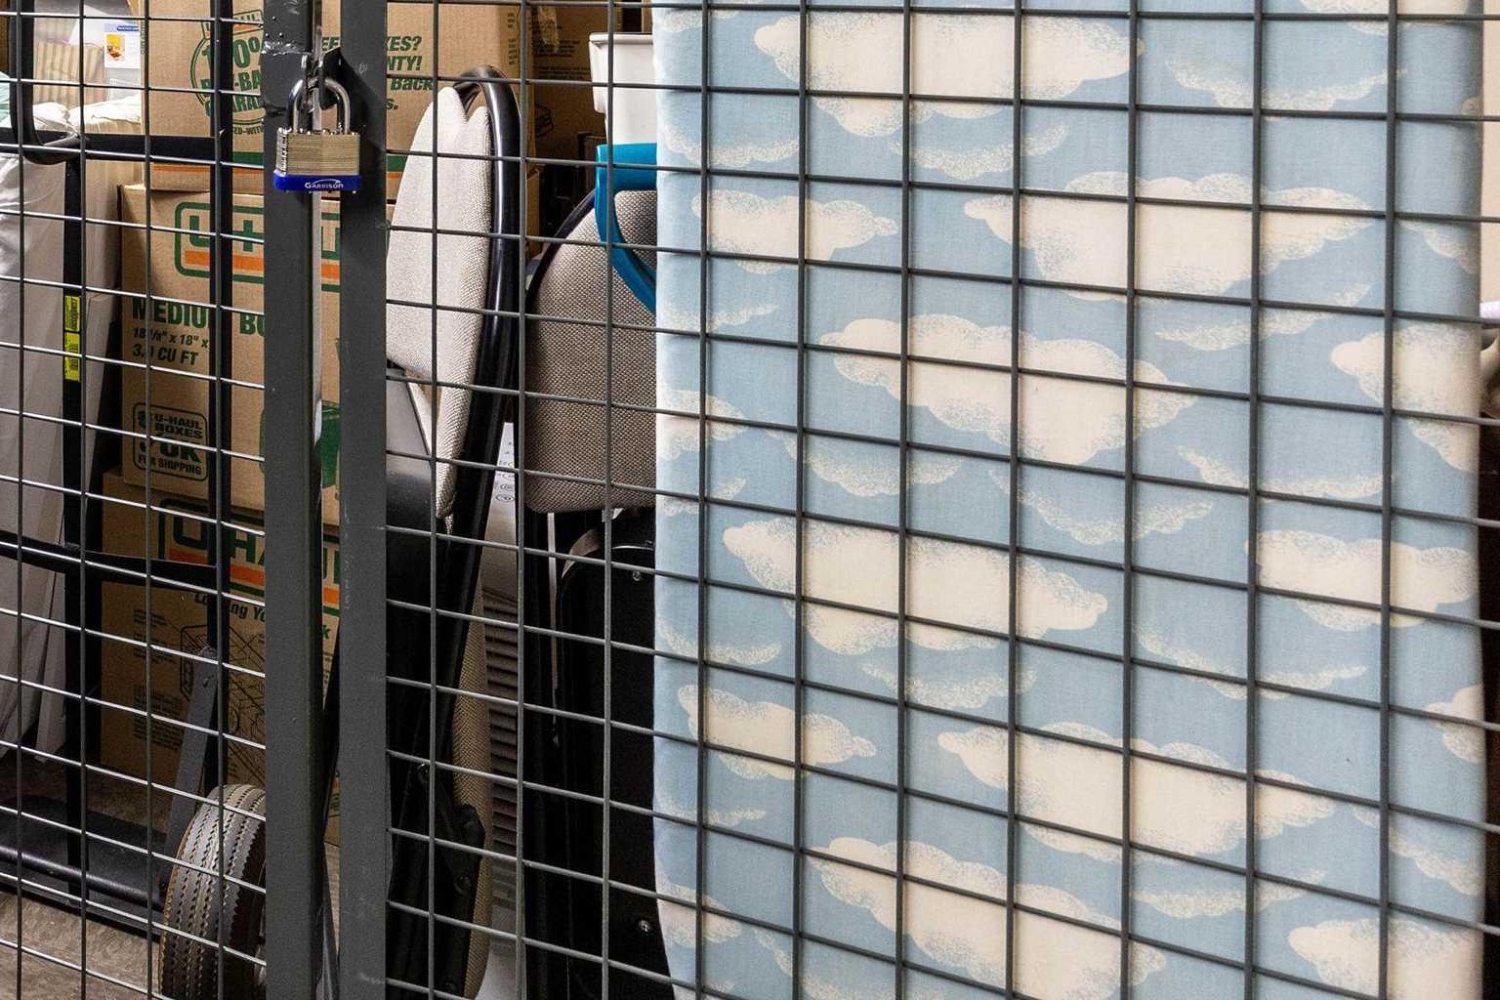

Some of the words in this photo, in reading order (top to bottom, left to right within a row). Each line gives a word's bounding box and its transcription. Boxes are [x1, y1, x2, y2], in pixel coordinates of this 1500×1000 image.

[132, 298, 209, 329] MEDIU
[158, 346, 177, 362] CU
[180, 351, 199, 366] FT
